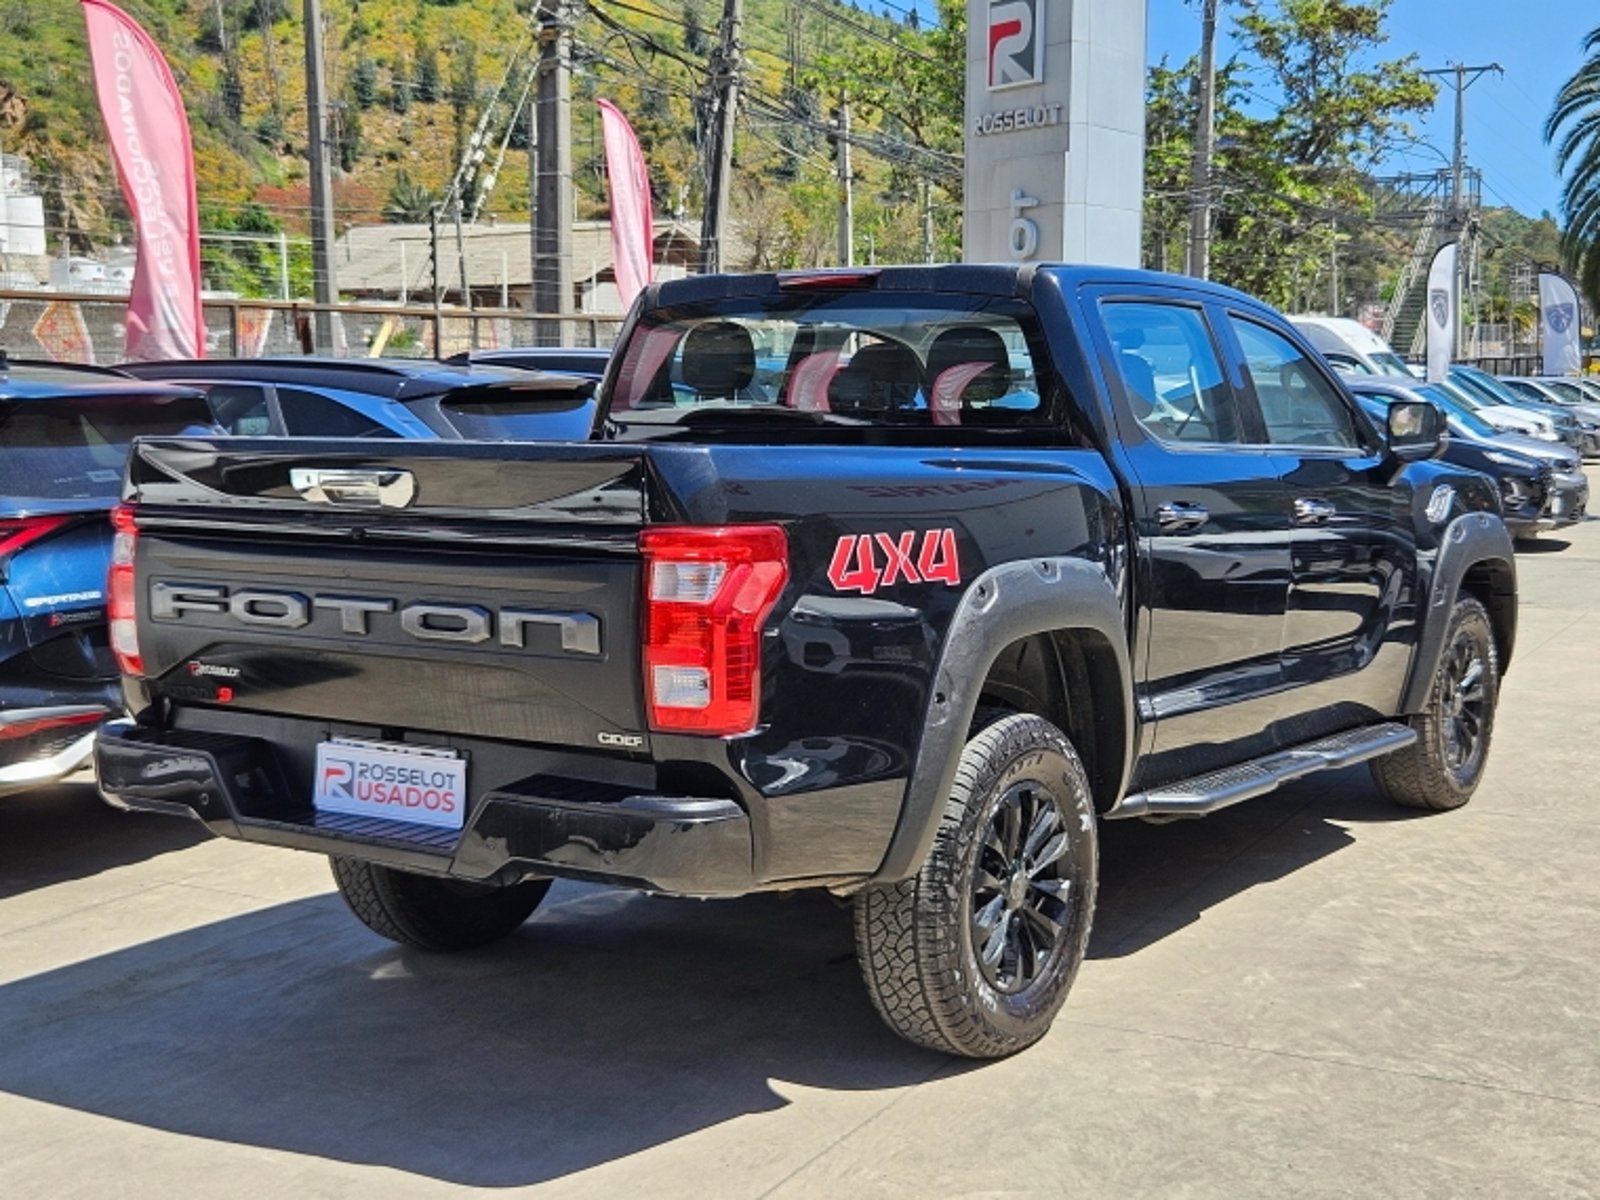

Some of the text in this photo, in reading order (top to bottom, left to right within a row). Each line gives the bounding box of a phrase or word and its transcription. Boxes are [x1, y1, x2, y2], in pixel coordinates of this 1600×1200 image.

[974, 104, 1061, 136] ROSSELOT
[152, 580, 601, 656] FOTON
[357, 763, 456, 789] ROSSELOT
[357, 781, 456, 813] USADOS
